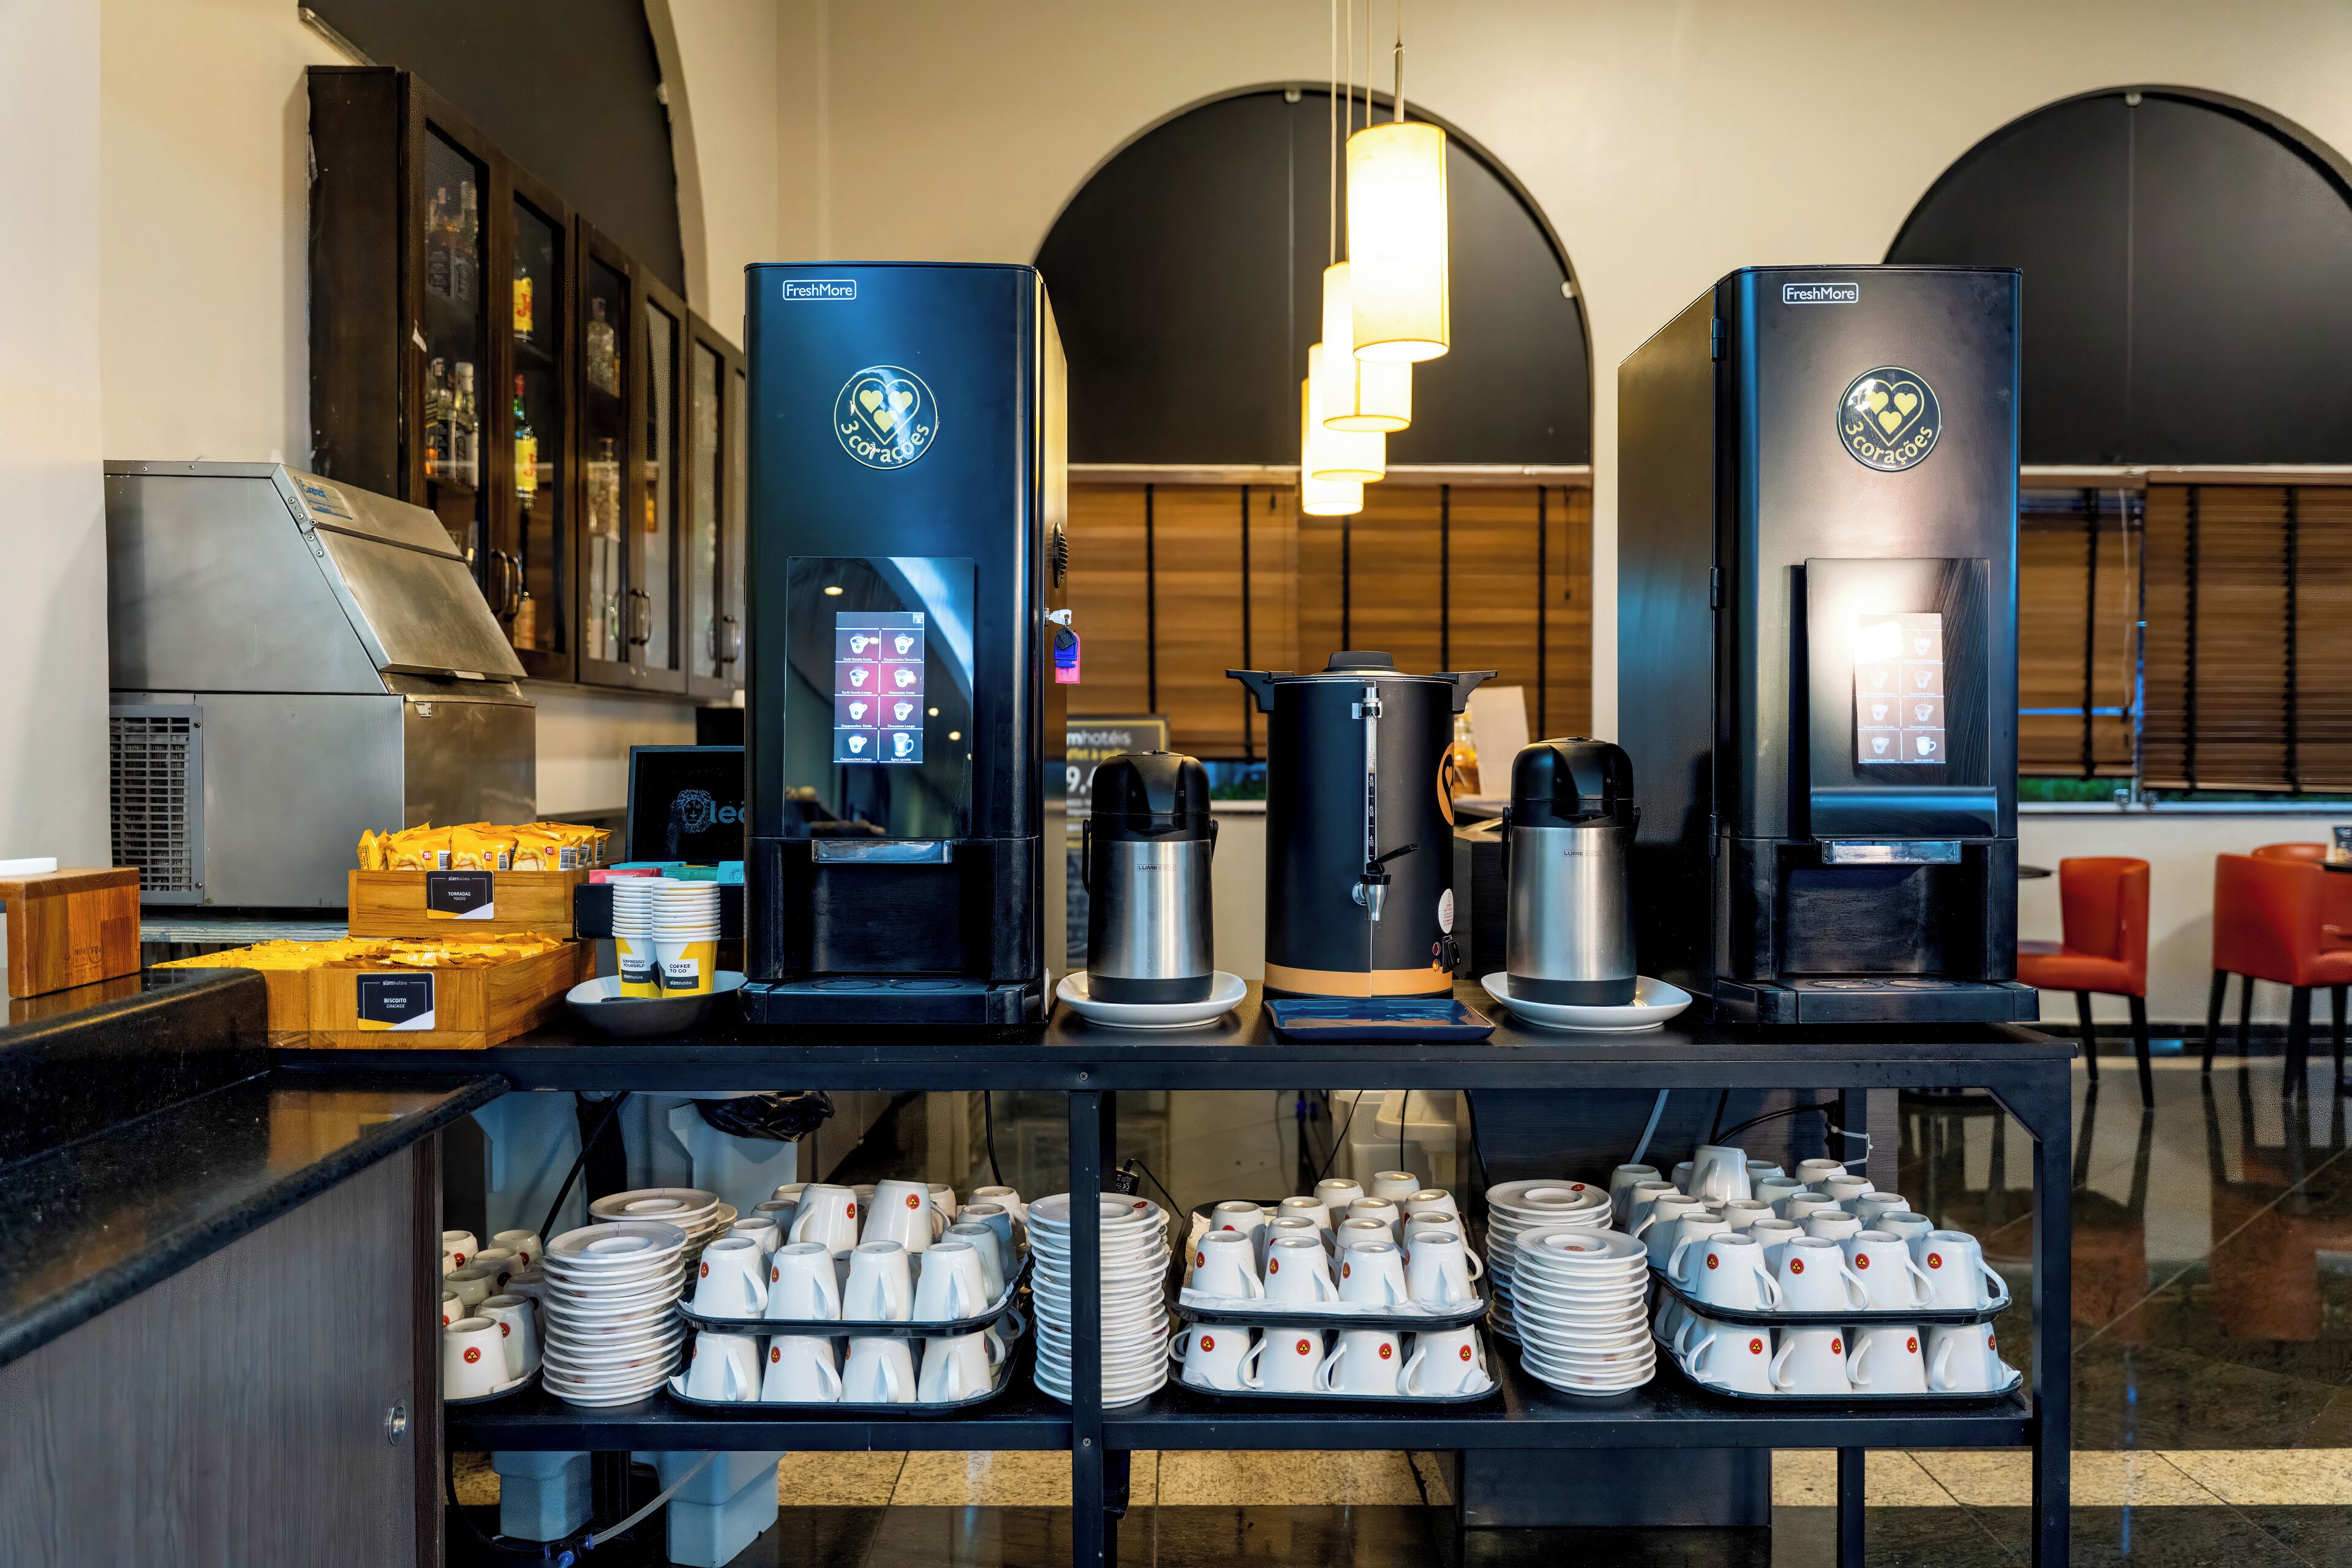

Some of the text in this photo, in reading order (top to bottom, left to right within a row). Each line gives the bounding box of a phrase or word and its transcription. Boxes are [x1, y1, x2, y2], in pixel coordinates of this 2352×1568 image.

[786, 284, 853, 297] FreshMore
[1787, 287, 1855, 300] FreshMore
[841, 420, 929, 464] 3 corações
[1845, 421, 1933, 465] 3 corações
[1067, 729, 1132, 746] mhotéis
